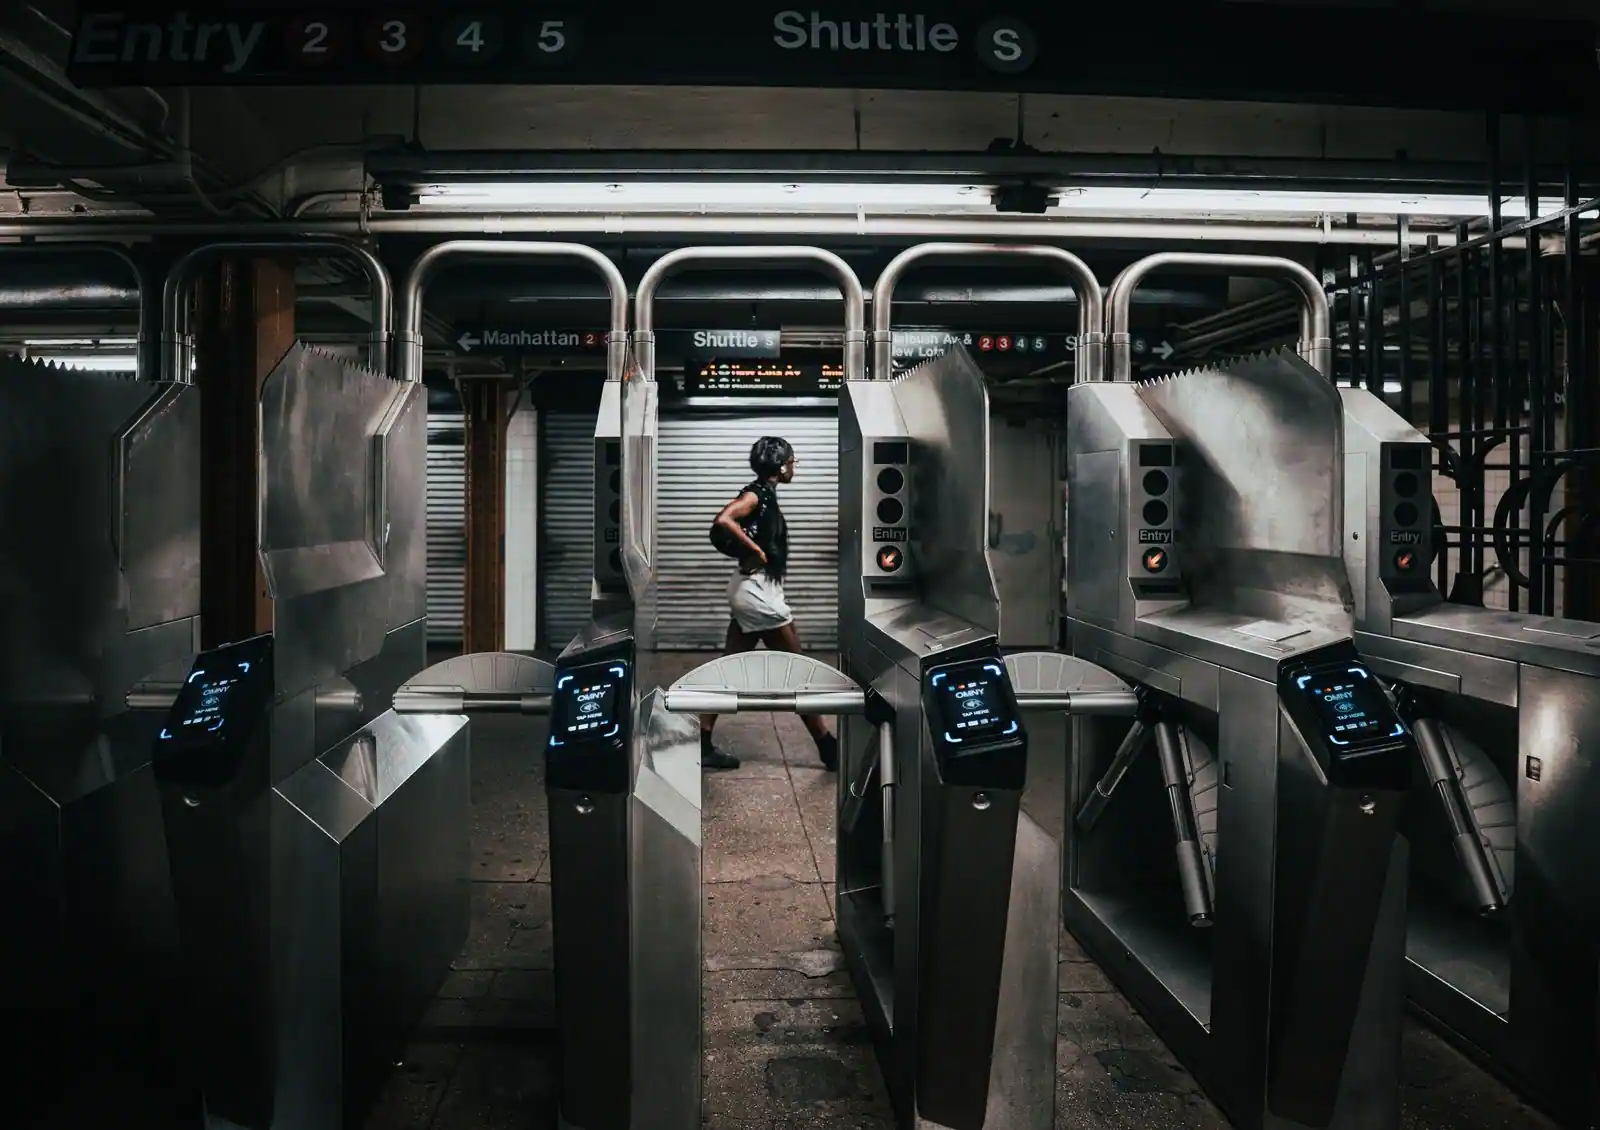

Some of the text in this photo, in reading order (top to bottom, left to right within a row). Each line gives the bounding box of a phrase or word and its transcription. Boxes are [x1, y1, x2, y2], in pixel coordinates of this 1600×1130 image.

[74, 10, 566, 74] Entry 2 3 4 5
[773, 9, 1022, 61] Shuttle S
[483, 329, 579, 346] Manhattan
[693, 331, 758, 348] Shuttle
[963, 333, 972, 345] &
[873, 528, 906, 542] Entry
[1139, 529, 1171, 543] Entry
[1390, 530, 1421, 544] Entry
[577, 690, 606, 702] OMNY
[955, 688, 985, 699] OMNY
[1323, 691, 1354, 702] OMNY
